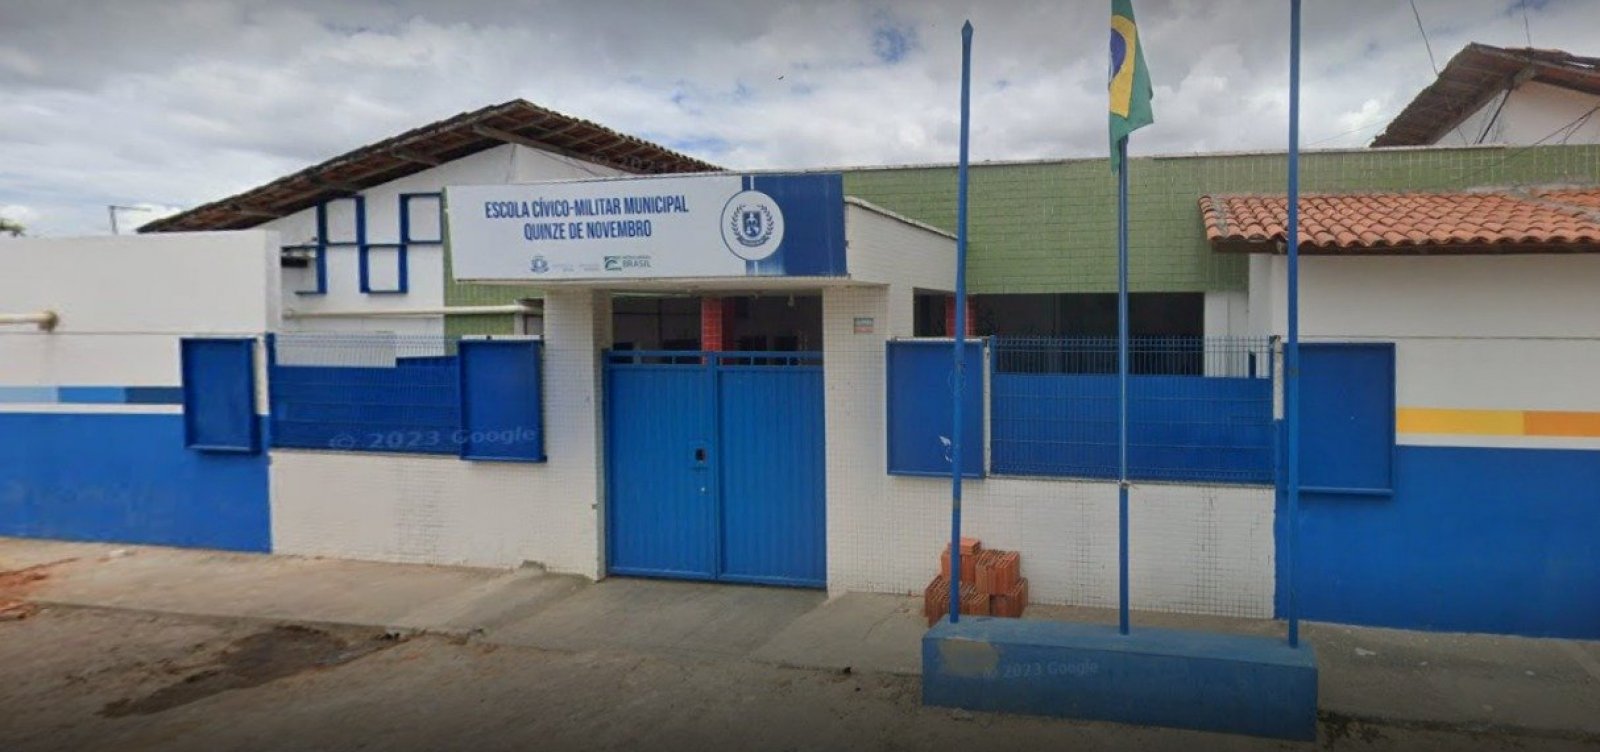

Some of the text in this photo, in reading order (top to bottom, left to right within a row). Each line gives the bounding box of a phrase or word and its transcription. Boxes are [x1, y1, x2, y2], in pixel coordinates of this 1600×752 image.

[485, 195, 689, 219] ESCOLA CÍVICO-MILITAR MUNICIPAL
[524, 218, 652, 241] QUINZE DE NOVEMBRO
[622, 259, 651, 268] BRASIL
